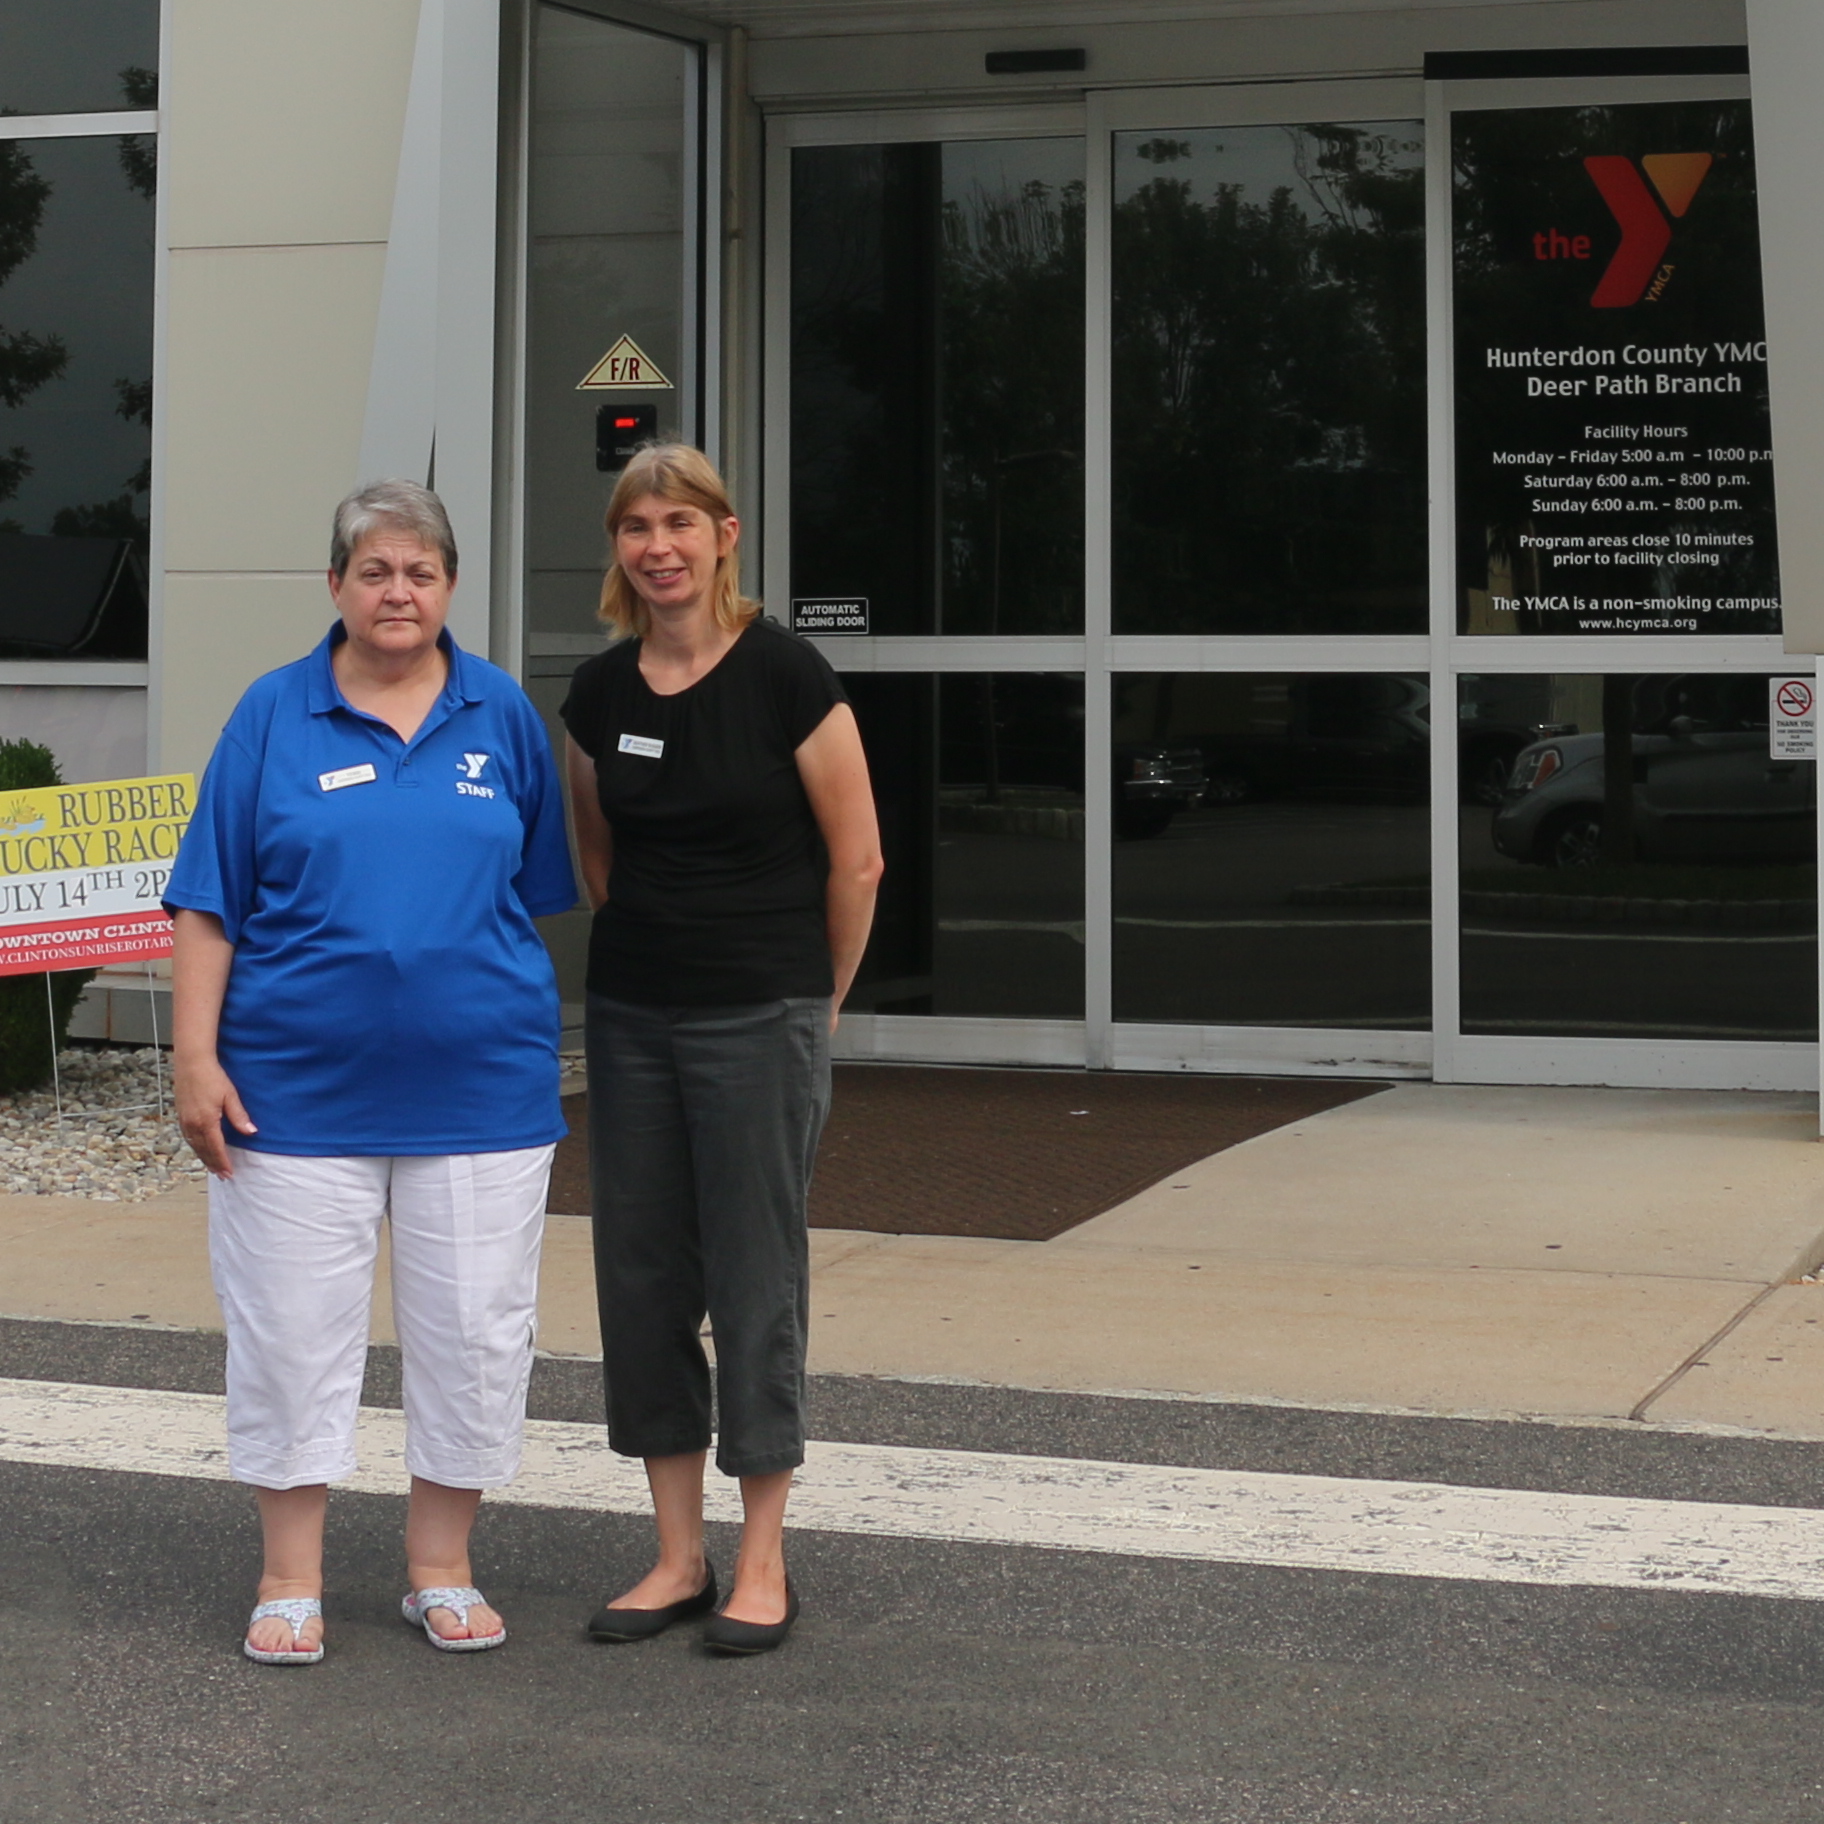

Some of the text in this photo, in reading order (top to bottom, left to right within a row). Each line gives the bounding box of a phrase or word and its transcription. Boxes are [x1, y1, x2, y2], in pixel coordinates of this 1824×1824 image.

[1533, 228, 1591, 260] the
[1645, 264, 1675, 303] YMCA
[1487, 346, 1616, 367] Hunterdon
[1622, 344, 1708, 366] County
[611, 357, 640, 381] F/R
[1527, 373, 1741, 396] Deer Path Branch
[1585, 425, 1688, 440] Facility Hours
[1493, 451, 1554, 466] Monday
[1570, 450, 1618, 465] Friday
[1622, 449, 1652, 462] 5:00
[1707, 448, 1745, 461] 10:00
[1524, 475, 1593, 489] Saturday
[1596, 474, 1627, 487] 6:00
[1631, 475, 1664, 486] a.m.
[1680, 473, 1711, 486] 8:00
[1717, 475, 1750, 488] p.m.
[1532, 499, 1588, 514] Sunday
[1591, 498, 1622, 511] 6:00
[1626, 500, 1658, 511] a.m.
[1675, 497, 1705, 510] 8:00
[1709, 499, 1743, 512] p.m.
[1520, 533, 1754, 549] Program areas close 10 minutes
[1553, 551, 1719, 567] prior to facility closing
[801, 604, 860, 615] AUTOMATIC
[1492, 596, 1520, 610] The
[1524, 596, 1569, 610] YMCA
[1573, 595, 1585, 610] is
[1589, 599, 1599, 610] a
[1603, 595, 1711, 612] non-smoking
[796, 616, 865, 627] SLIDING DOOR
[1579, 617, 1697, 631] www.hcymca.org
[456, 782, 495, 799] STAFF
[58, 782, 190, 829] RUBBER
[134, 868, 173, 899] 2P
